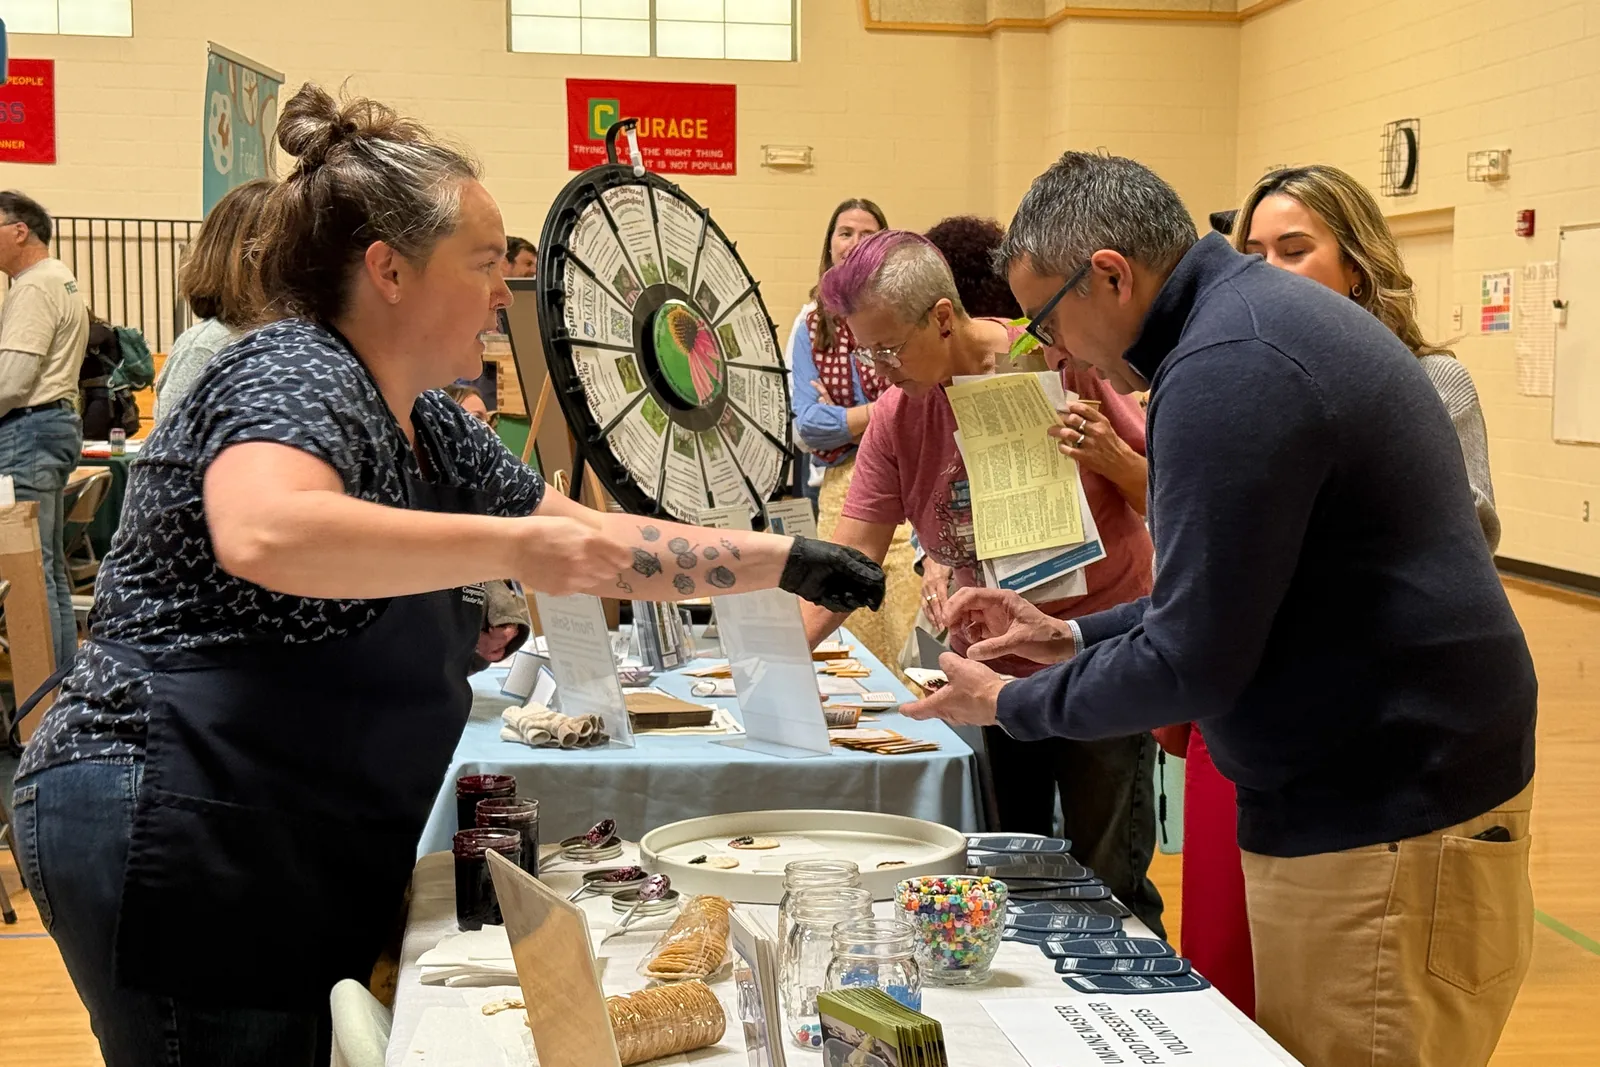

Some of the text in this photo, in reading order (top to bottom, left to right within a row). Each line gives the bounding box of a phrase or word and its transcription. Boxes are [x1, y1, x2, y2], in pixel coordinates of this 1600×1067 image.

[7, 76, 44, 86] PEOPLE
[642, 147, 660, 156] THE
[664, 149, 692, 157] RIGHT
[695, 149, 723, 158] THING
[657, 161, 666, 169] IS
[669, 161, 688, 170] NOT
[691, 162, 732, 170] POPULAR
[565, 261, 577, 337] Spin Again!
[774, 375, 784, 402] Spin
[1054, 1005, 1124, 1064] UMAINE MASTER
[1087, 1002, 1166, 1064] FOOD PRESERVER
[1130, 1008, 1193, 1055] VOLUNTEERS
